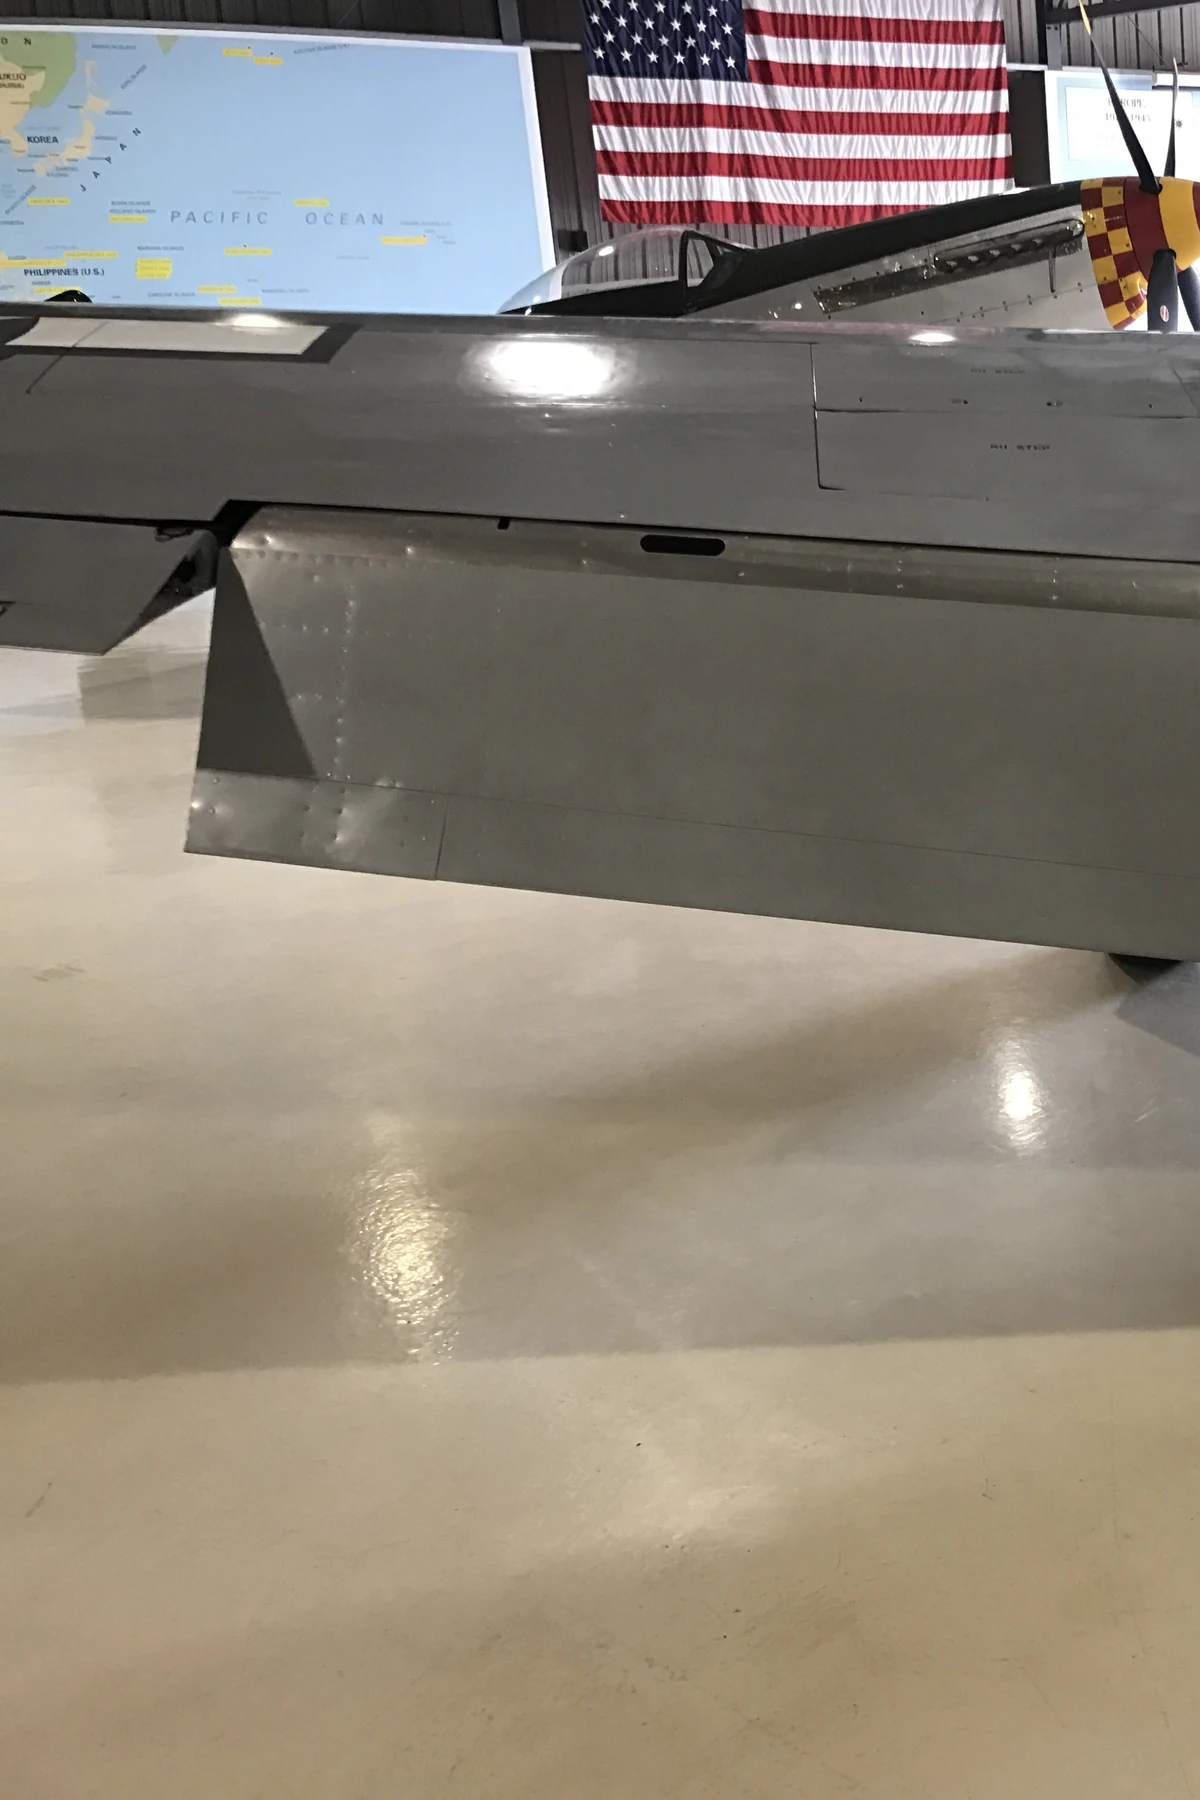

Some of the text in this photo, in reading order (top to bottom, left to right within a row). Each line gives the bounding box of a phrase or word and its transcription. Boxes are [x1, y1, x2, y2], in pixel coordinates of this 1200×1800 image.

[27, 136, 59, 144] KOREA
[170, 210, 384, 226] PACIFIC OCEAN
[23, 268, 79, 277] PHILIPPINES
